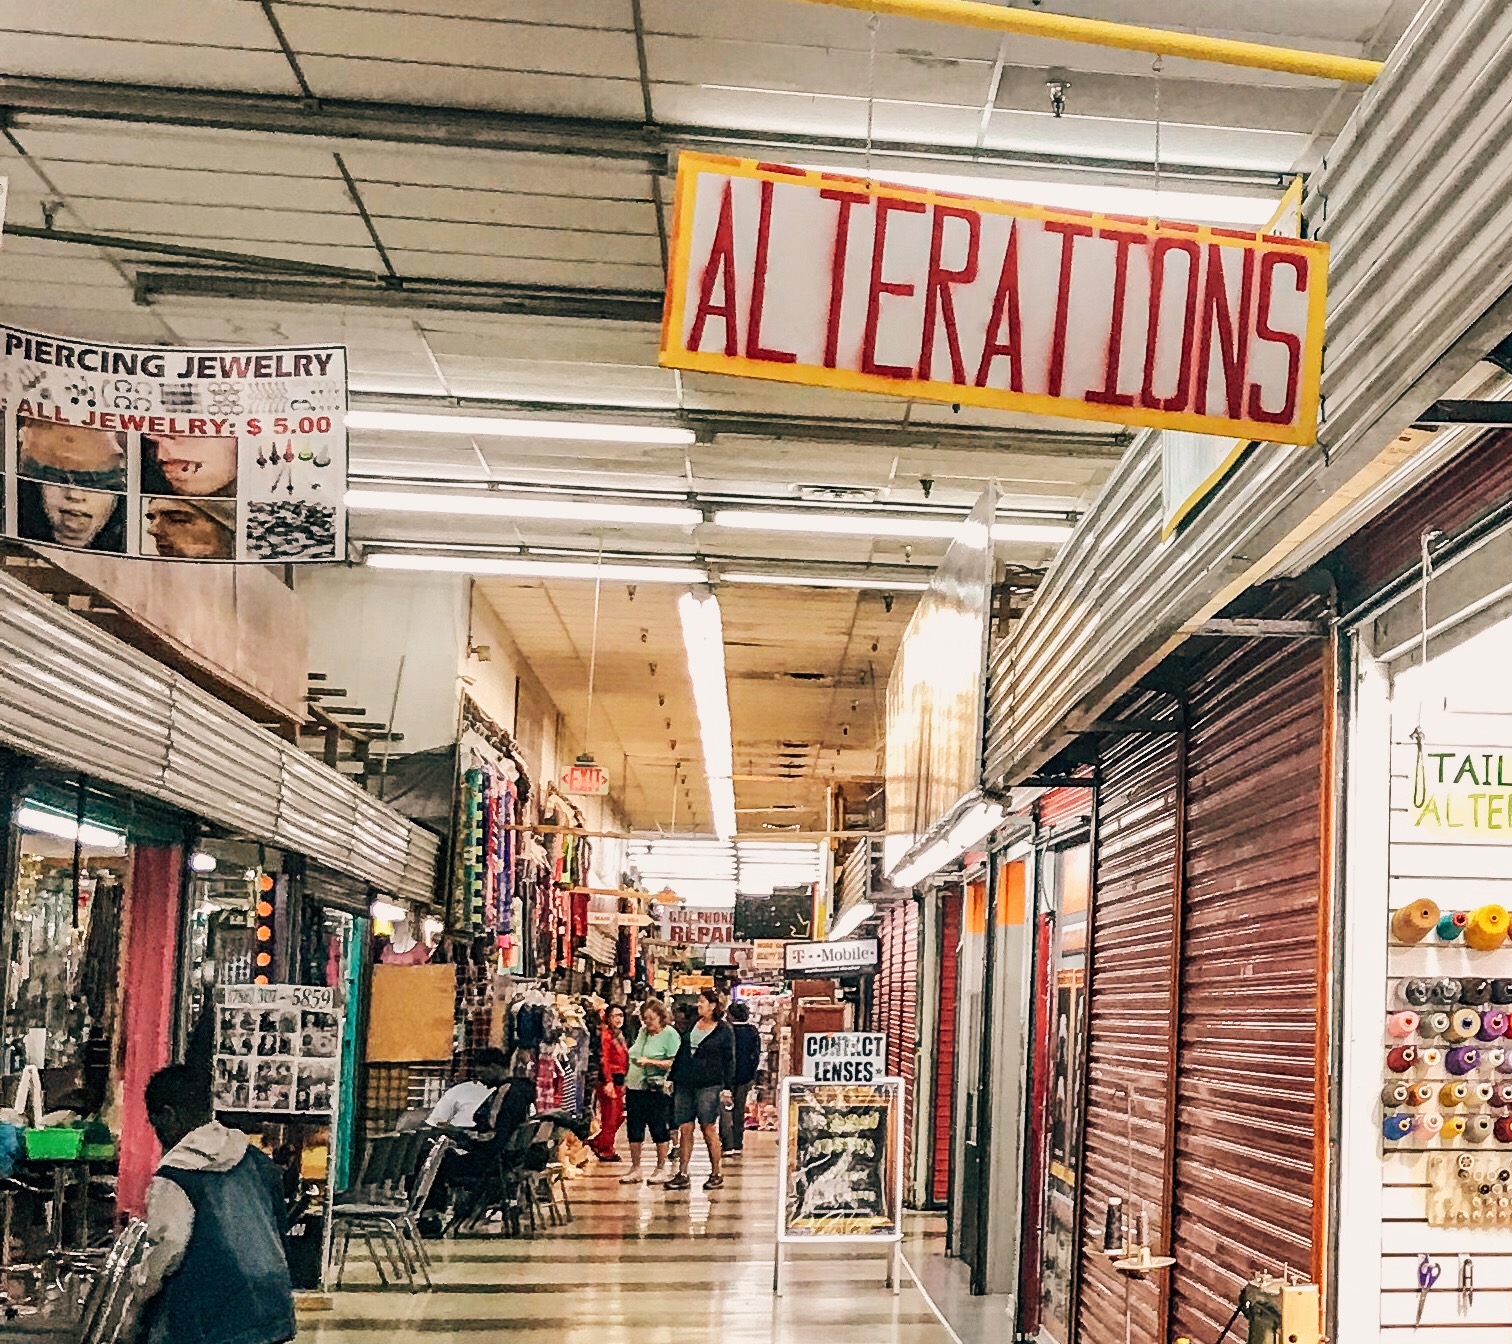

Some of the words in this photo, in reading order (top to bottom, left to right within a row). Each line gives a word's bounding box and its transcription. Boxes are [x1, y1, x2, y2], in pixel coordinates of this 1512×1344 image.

[686, 178, 1309, 425] ALTERATIONS
[5, 332, 166, 378] PIERCING
[177, 353, 333, 379] JEWELRY
[17, 397, 71, 424] ALL
[82, 411, 236, 436] JEWELRY:
[273, 416, 332, 435] 5.00
[670, 925, 732, 943] REPAI
[806, 1035, 883, 1058] CONTACT
[814, 1061, 874, 1082] LENSES
